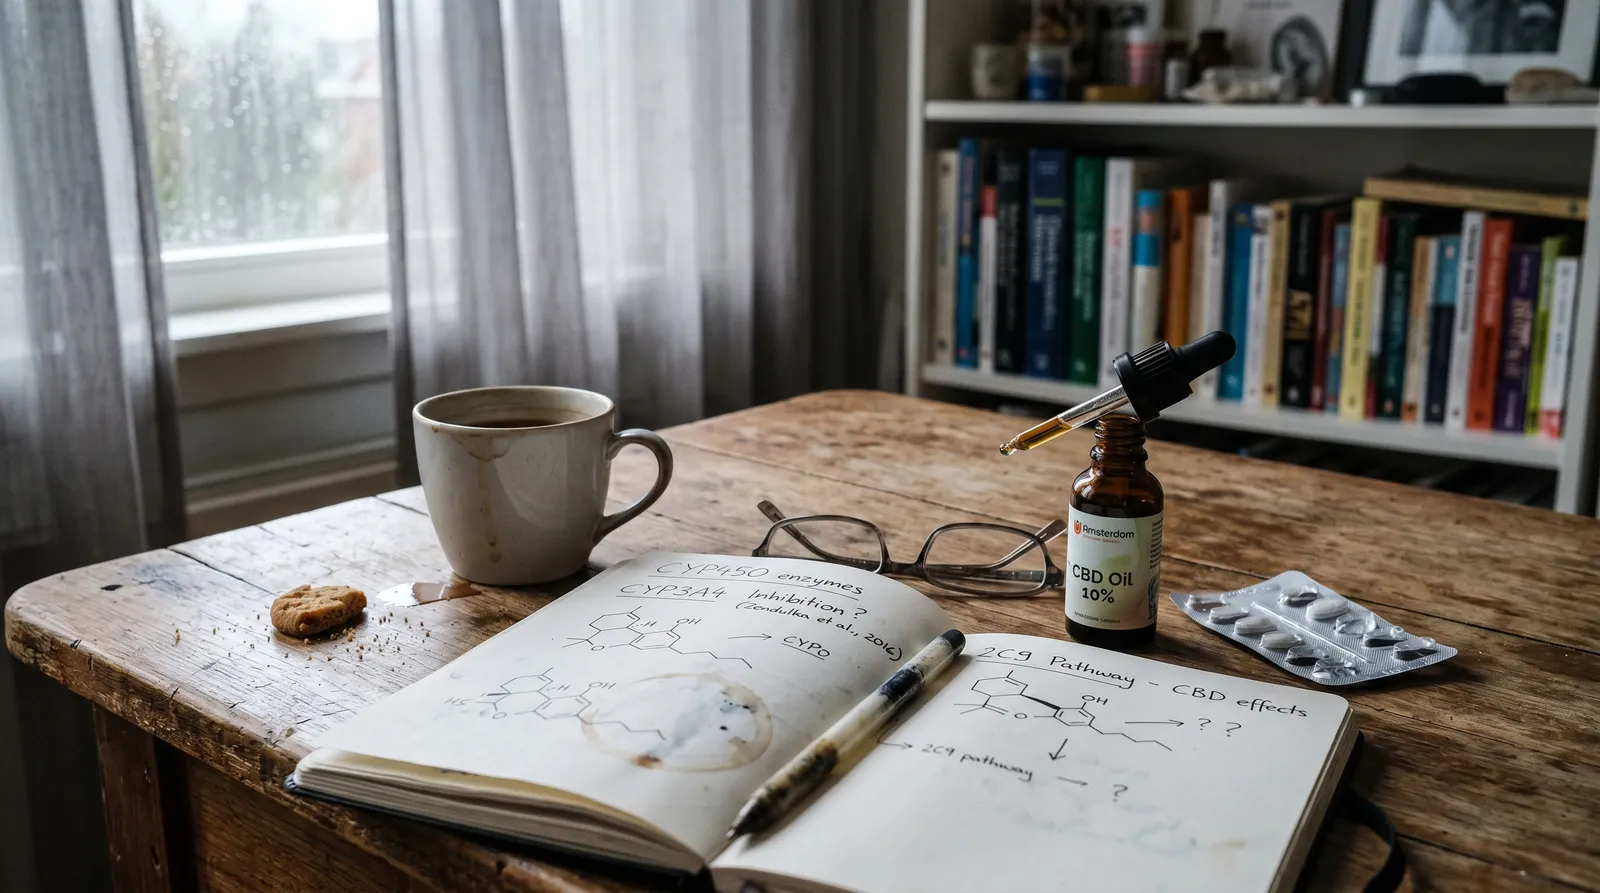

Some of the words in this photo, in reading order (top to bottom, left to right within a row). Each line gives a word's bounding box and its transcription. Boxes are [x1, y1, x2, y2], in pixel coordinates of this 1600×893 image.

[656, 562, 770, 577] CYP450
[777, 573, 864, 595] enzymes
[1072, 564, 1104, 584] CBD
[1108, 571, 1134, 587] Oil
[620, 583, 727, 598] CYP3A4
[748, 589, 844, 616] Inhibition
[1081, 587, 1115, 604] 10%
[676, 618, 702, 626] OH
[836, 623, 859, 637] al.,
[864, 633, 903, 662] 2016)
[588, 681, 617, 690] OH
[1050, 655, 1136, 690] Pathway
[1172, 684, 1226, 701] CBD
[1236, 698, 1308, 718] effects
[1081, 694, 1109, 706] OH
[1198, 717, 1211, 731] ?
[1226, 721, 1242, 737] ?
[921, 743, 955, 757] 2C9
[960, 752, 1034, 783] pathway
[1112, 783, 1129, 802] ?
